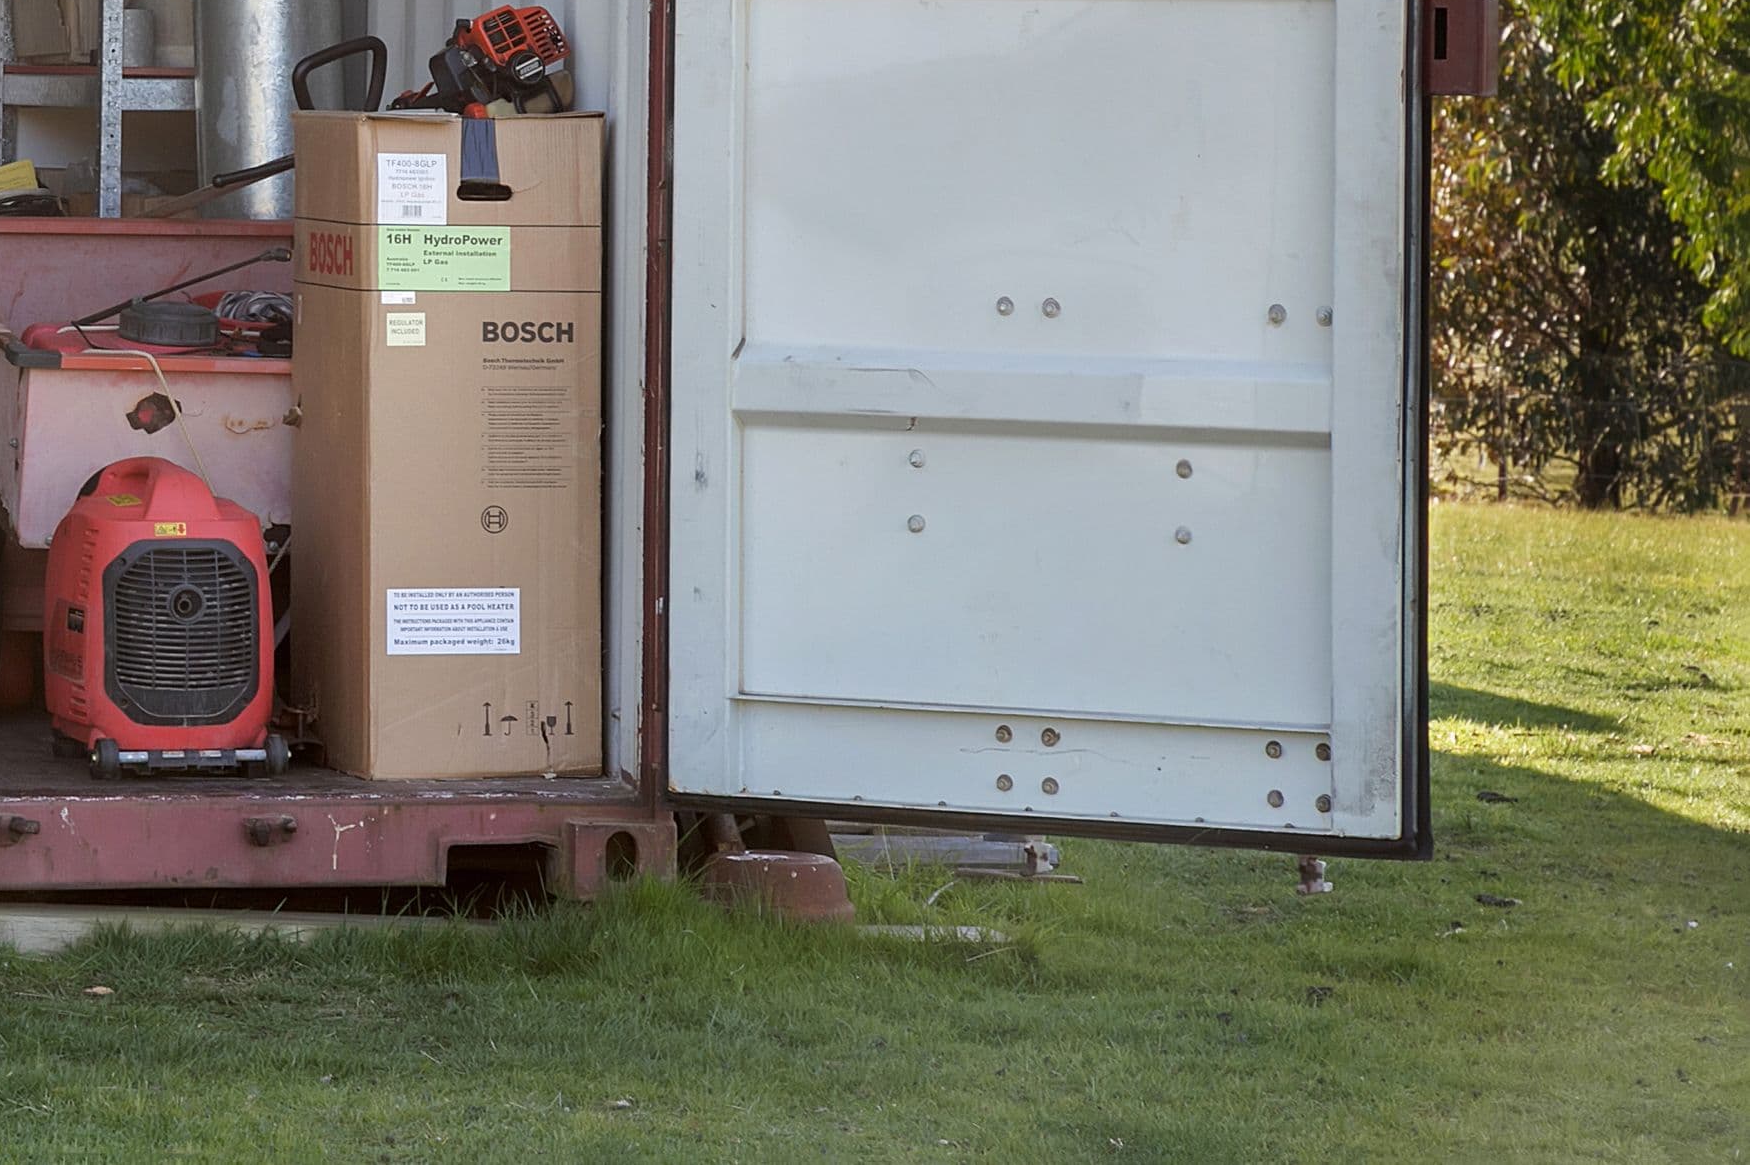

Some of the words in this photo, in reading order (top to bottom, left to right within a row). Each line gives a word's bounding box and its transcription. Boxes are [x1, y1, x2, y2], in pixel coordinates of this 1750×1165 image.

[386, 234, 412, 244] 16H
[424, 234, 503, 247] HydroPower
[310, 233, 353, 275] BOSCH
[482, 321, 574, 342] BOSCH
